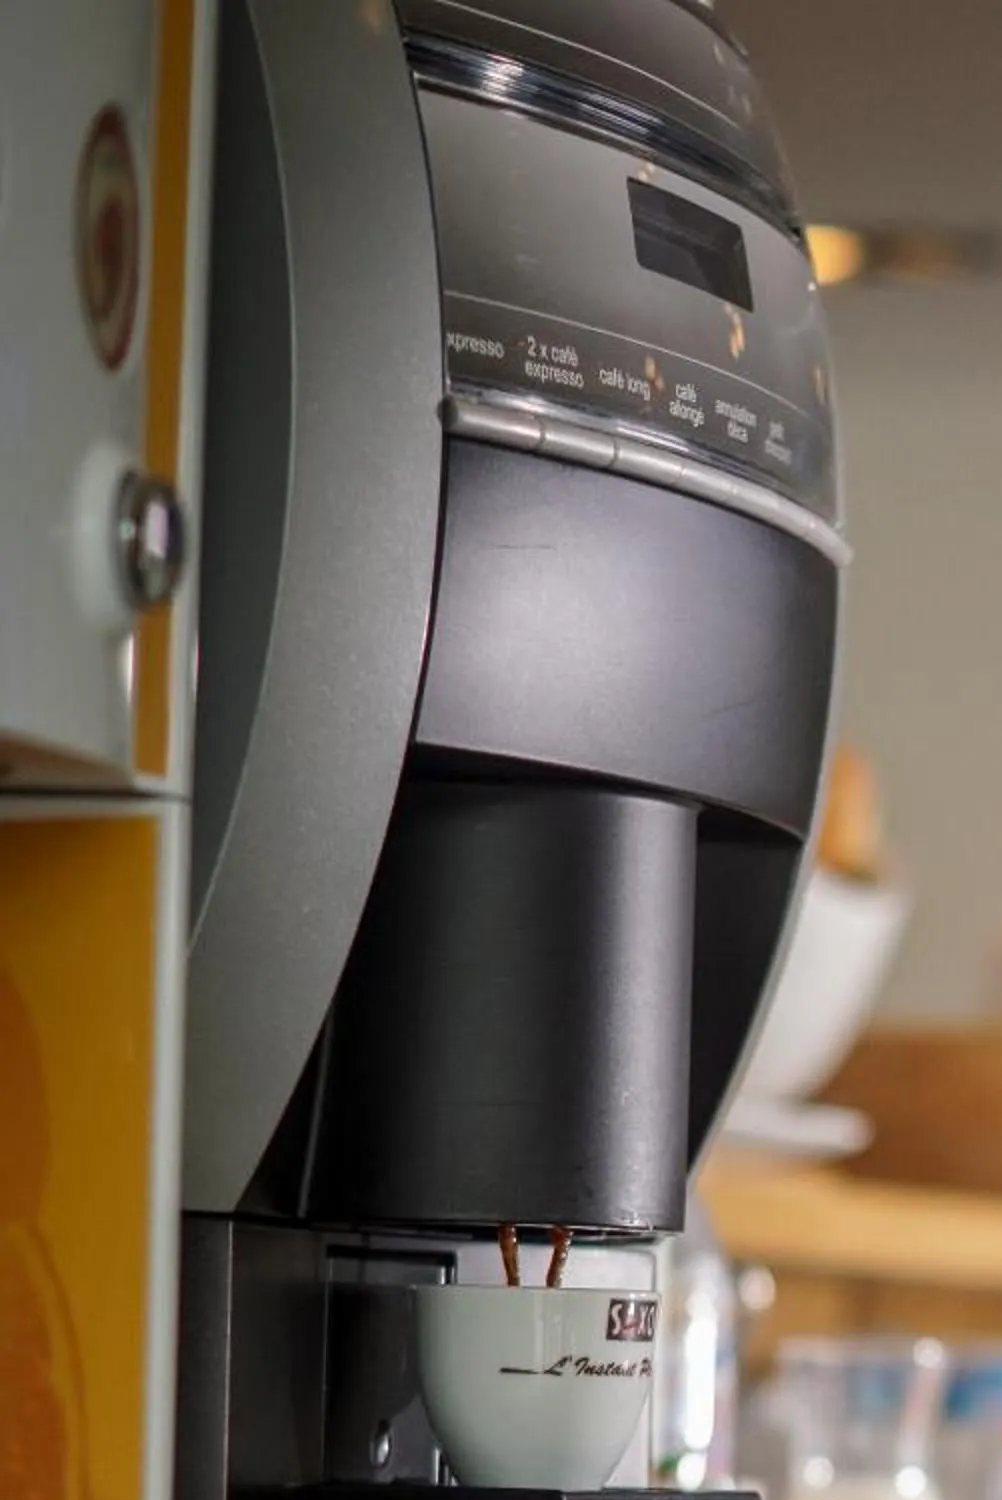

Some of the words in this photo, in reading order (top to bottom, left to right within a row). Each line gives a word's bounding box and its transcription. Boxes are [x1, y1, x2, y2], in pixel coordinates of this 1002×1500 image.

[446, 331, 505, 359] xpresso
[527, 335, 537, 357] 2
[540, 344, 549, 361] x
[551, 343, 579, 367] café
[525, 360, 585, 389] expresso
[599, 367, 625, 390] café
[626, 371, 651, 401] long
